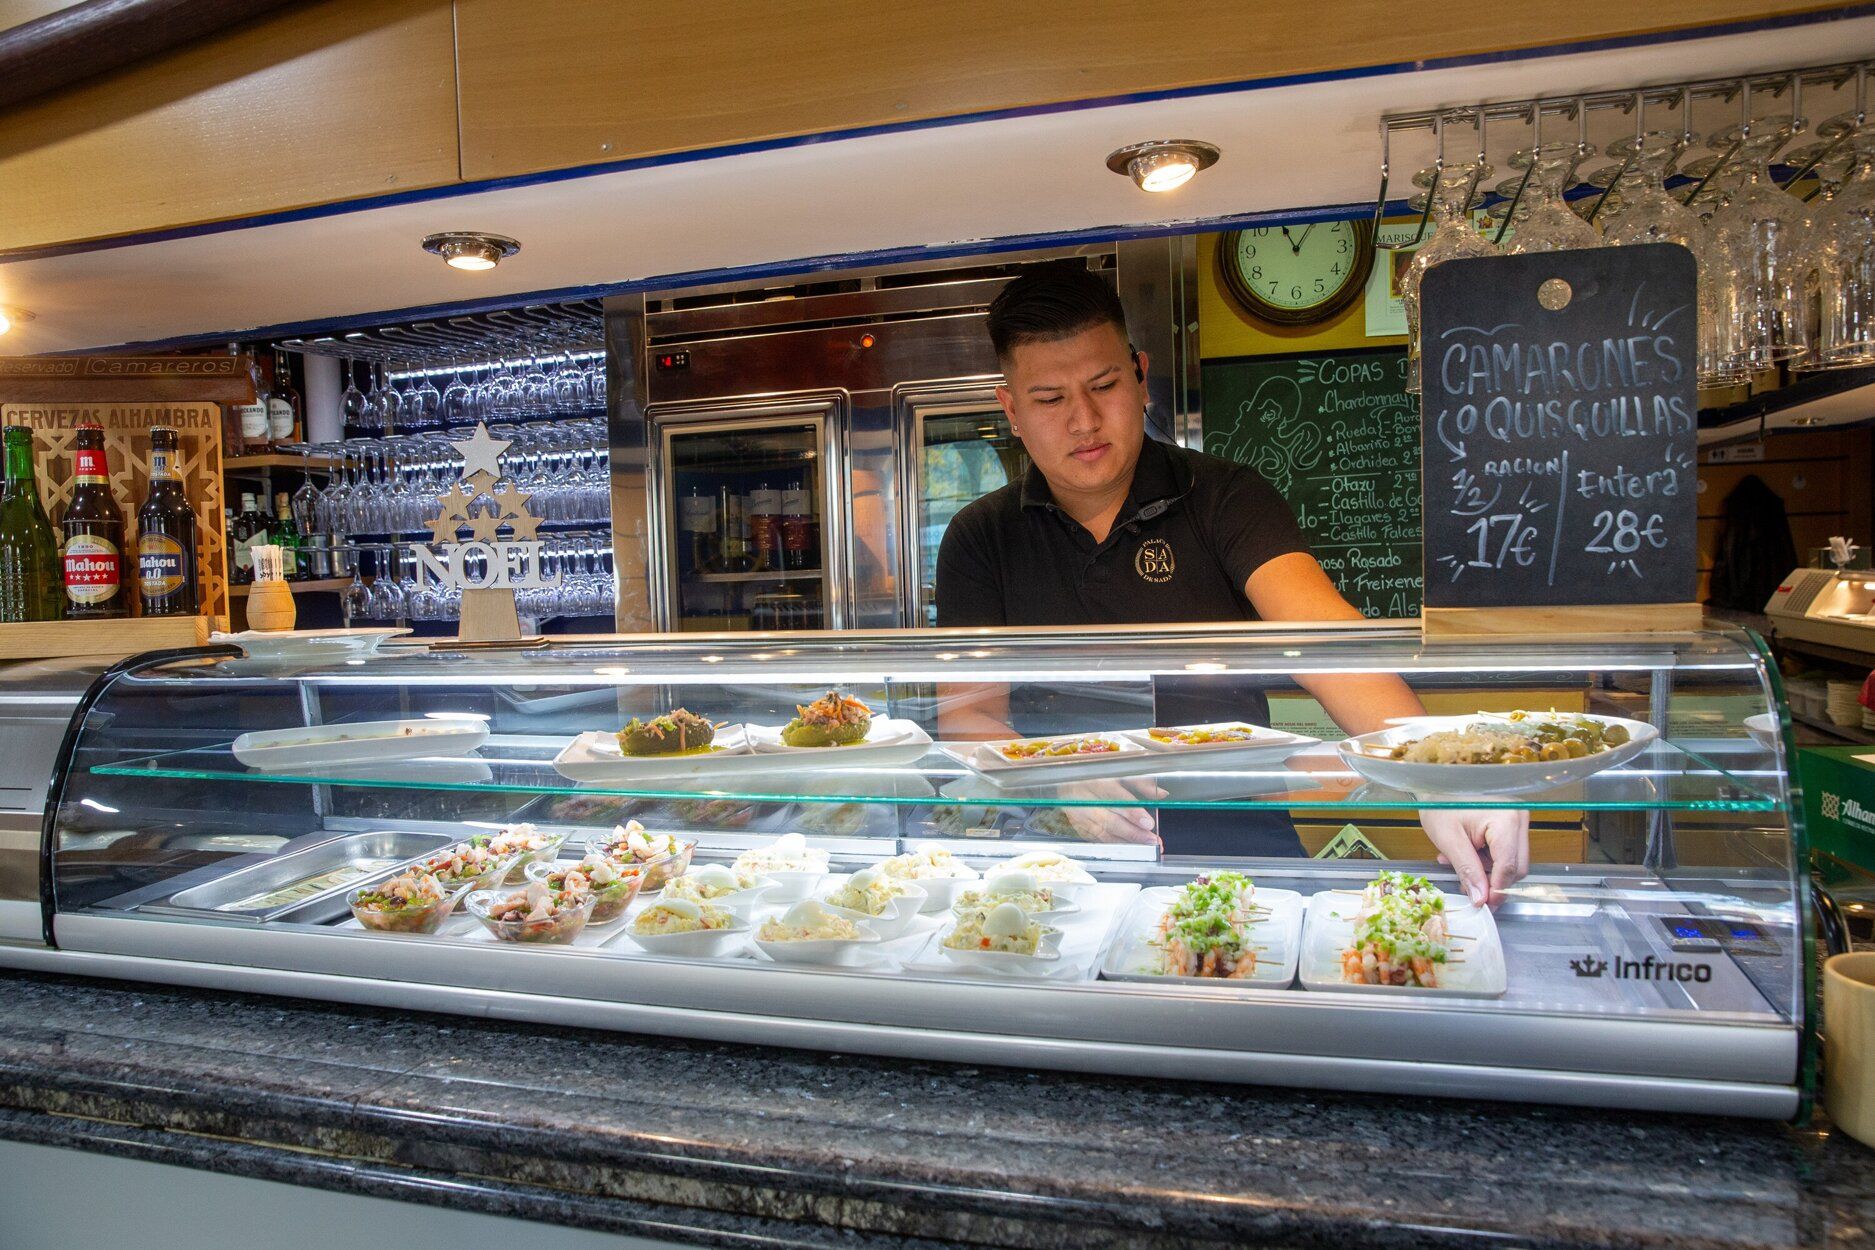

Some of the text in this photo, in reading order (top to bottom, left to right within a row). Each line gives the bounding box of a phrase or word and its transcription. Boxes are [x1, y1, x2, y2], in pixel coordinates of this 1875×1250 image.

[1245, 245, 1256, 259] 9
[1336, 240, 1347, 253] 3
[1252, 265, 1262, 280] 8
[1330, 262, 1341, 275] 4
[1269, 281, 1279, 295] 7
[1291, 285, 1302, 300] 6
[1313, 278, 1324, 293] 5
[91, 359, 231, 374] Camareros
[1319, 359, 1384, 384] COPAS
[1324, 389, 1410, 413] Chardonnay
[7, 408, 213, 429] CERVEZAS ALHAMBRA
[1331, 418, 1376, 440] Rueda
[1484, 458, 1559, 475] RACION
[1577, 465, 1679, 498] Entera
[1331, 492, 1384, 509] Castillo
[1389, 492, 1403, 508] de
[1330, 526, 1377, 540] Castillo
[1585, 509, 1669, 553] 28€
[1467, 514, 1538, 568] 17€
[65, 557, 115, 572] Mahou
[409, 541, 562, 592] NOEL
[1347, 547, 1402, 573] Rosado
[1615, 955, 1712, 983] Infrico
